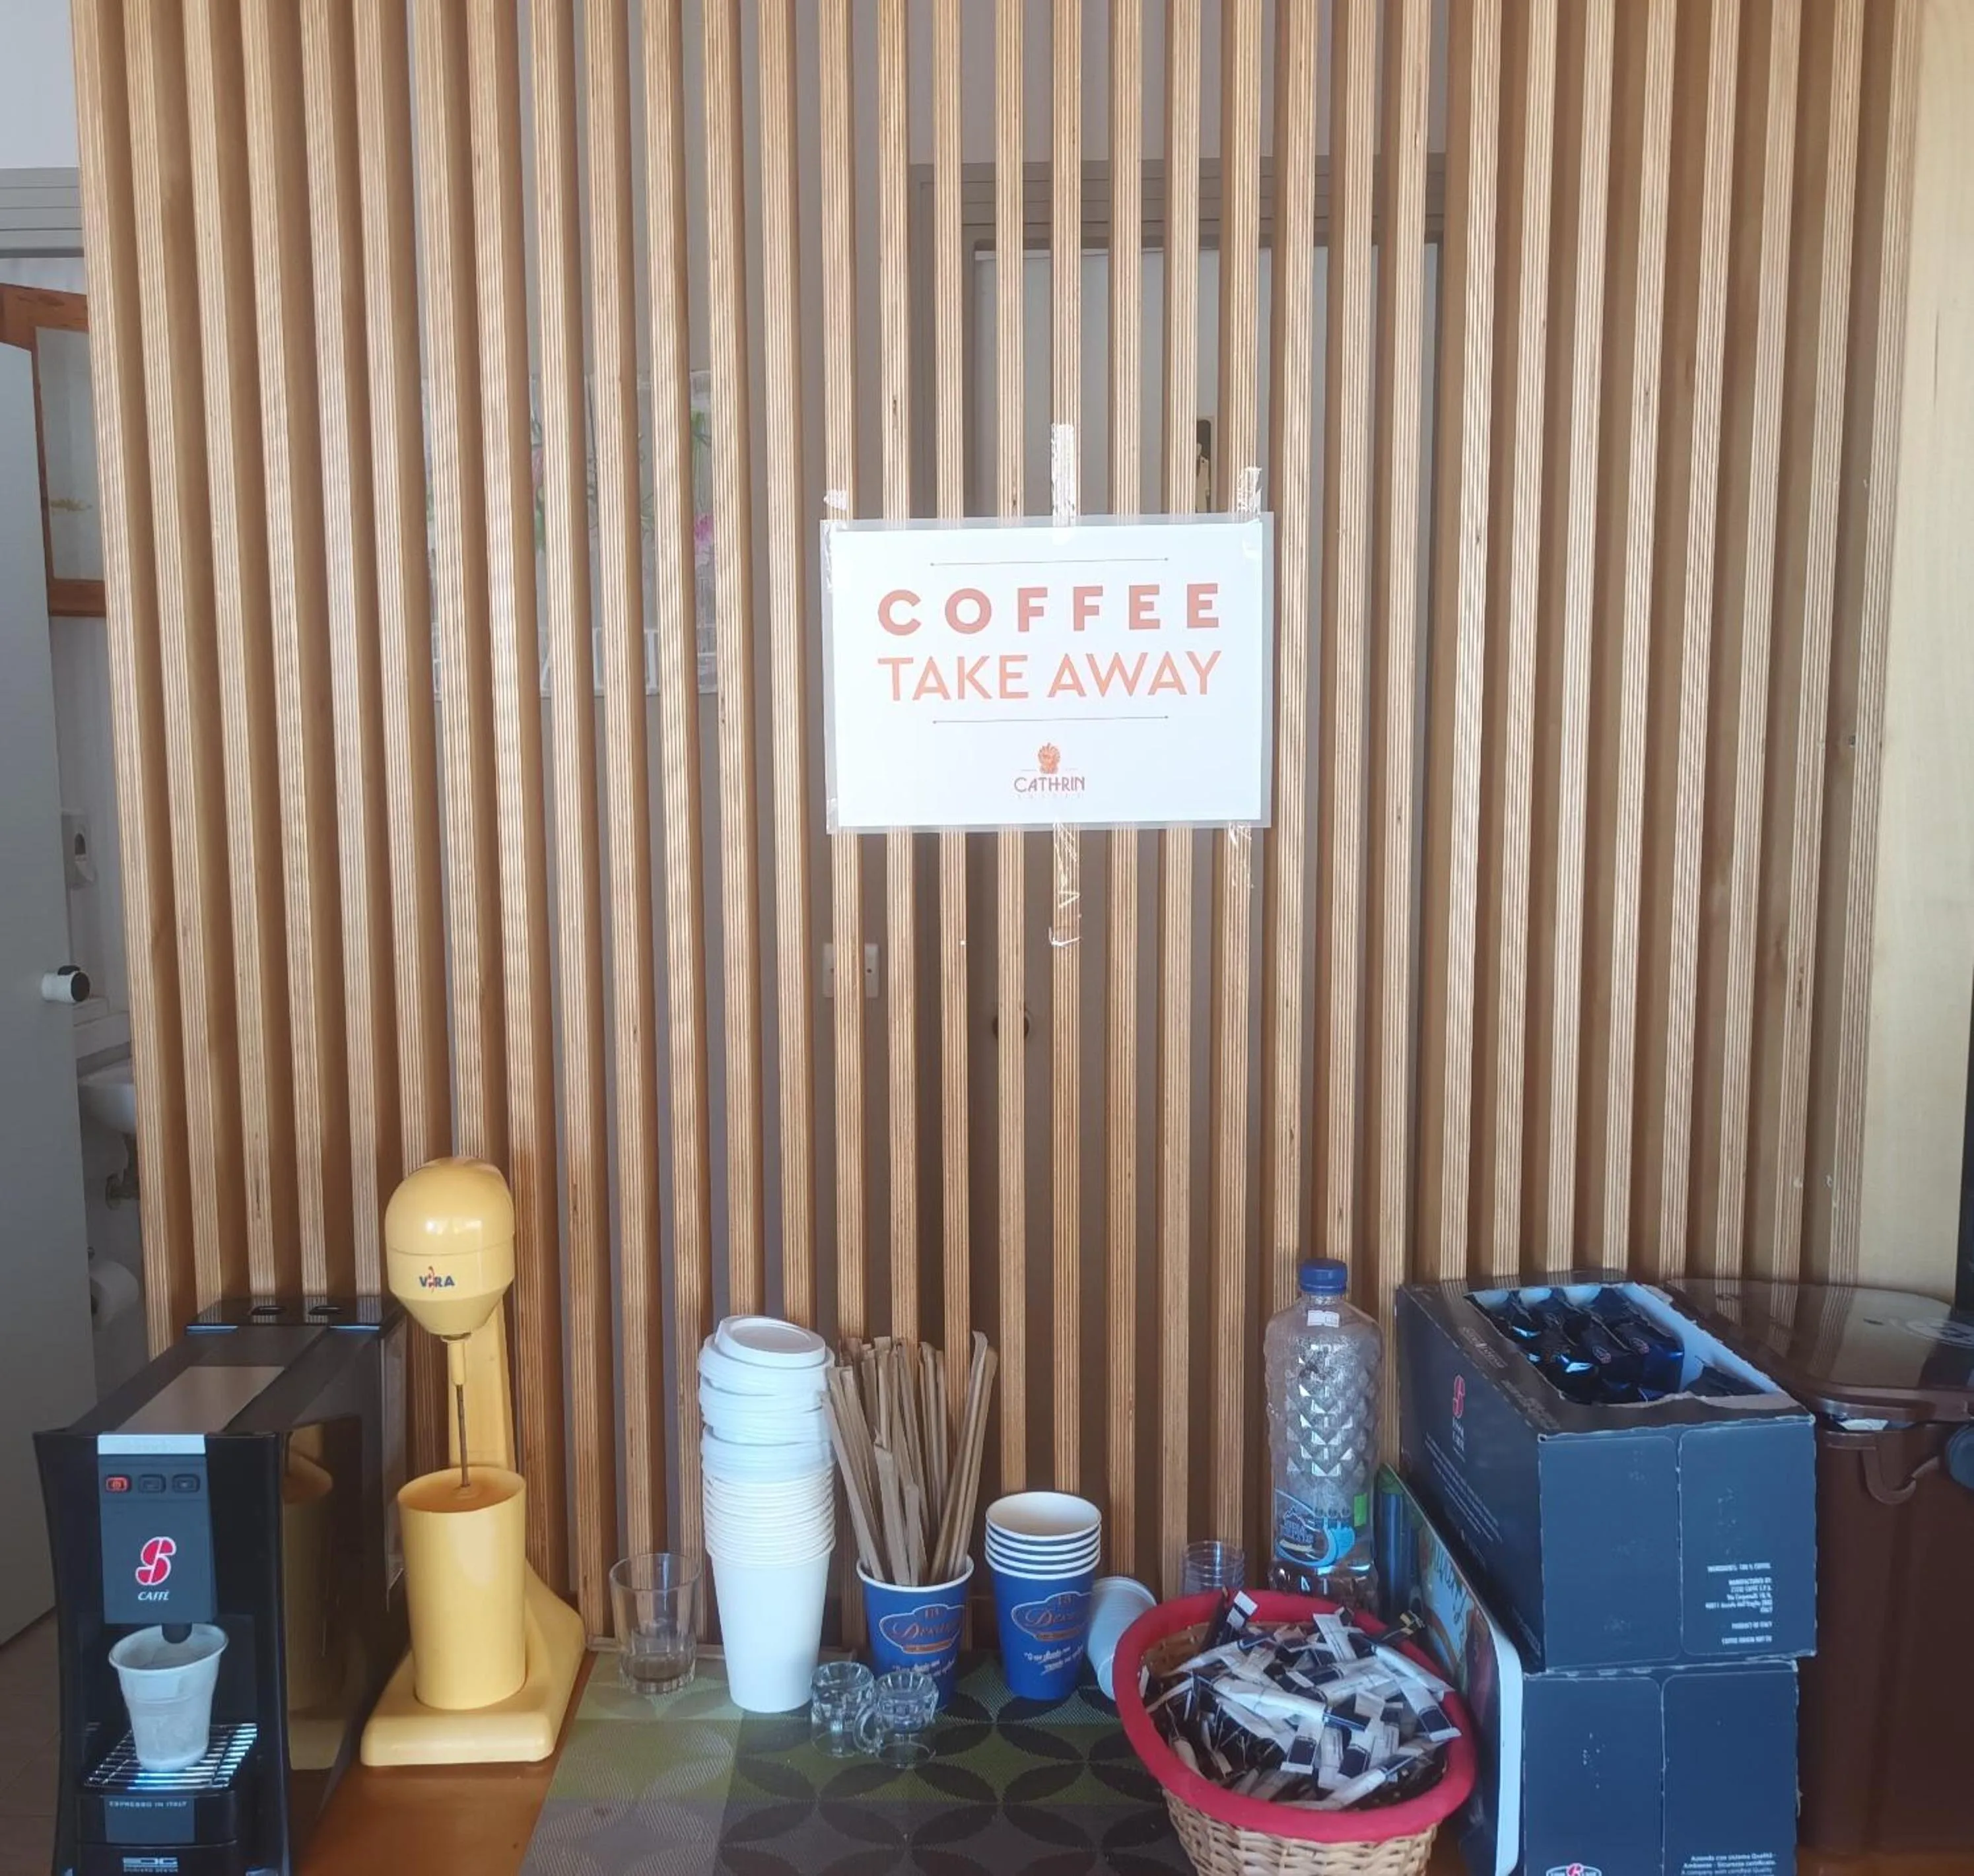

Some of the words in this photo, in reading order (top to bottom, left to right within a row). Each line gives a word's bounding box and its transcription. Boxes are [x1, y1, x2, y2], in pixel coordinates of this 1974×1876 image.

[877, 583, 1219, 636] COFFEE
[877, 654, 1029, 701] TAKE
[1047, 650, 1222, 698] AWAY
[1013, 776, 1085, 793] CATHRIN
